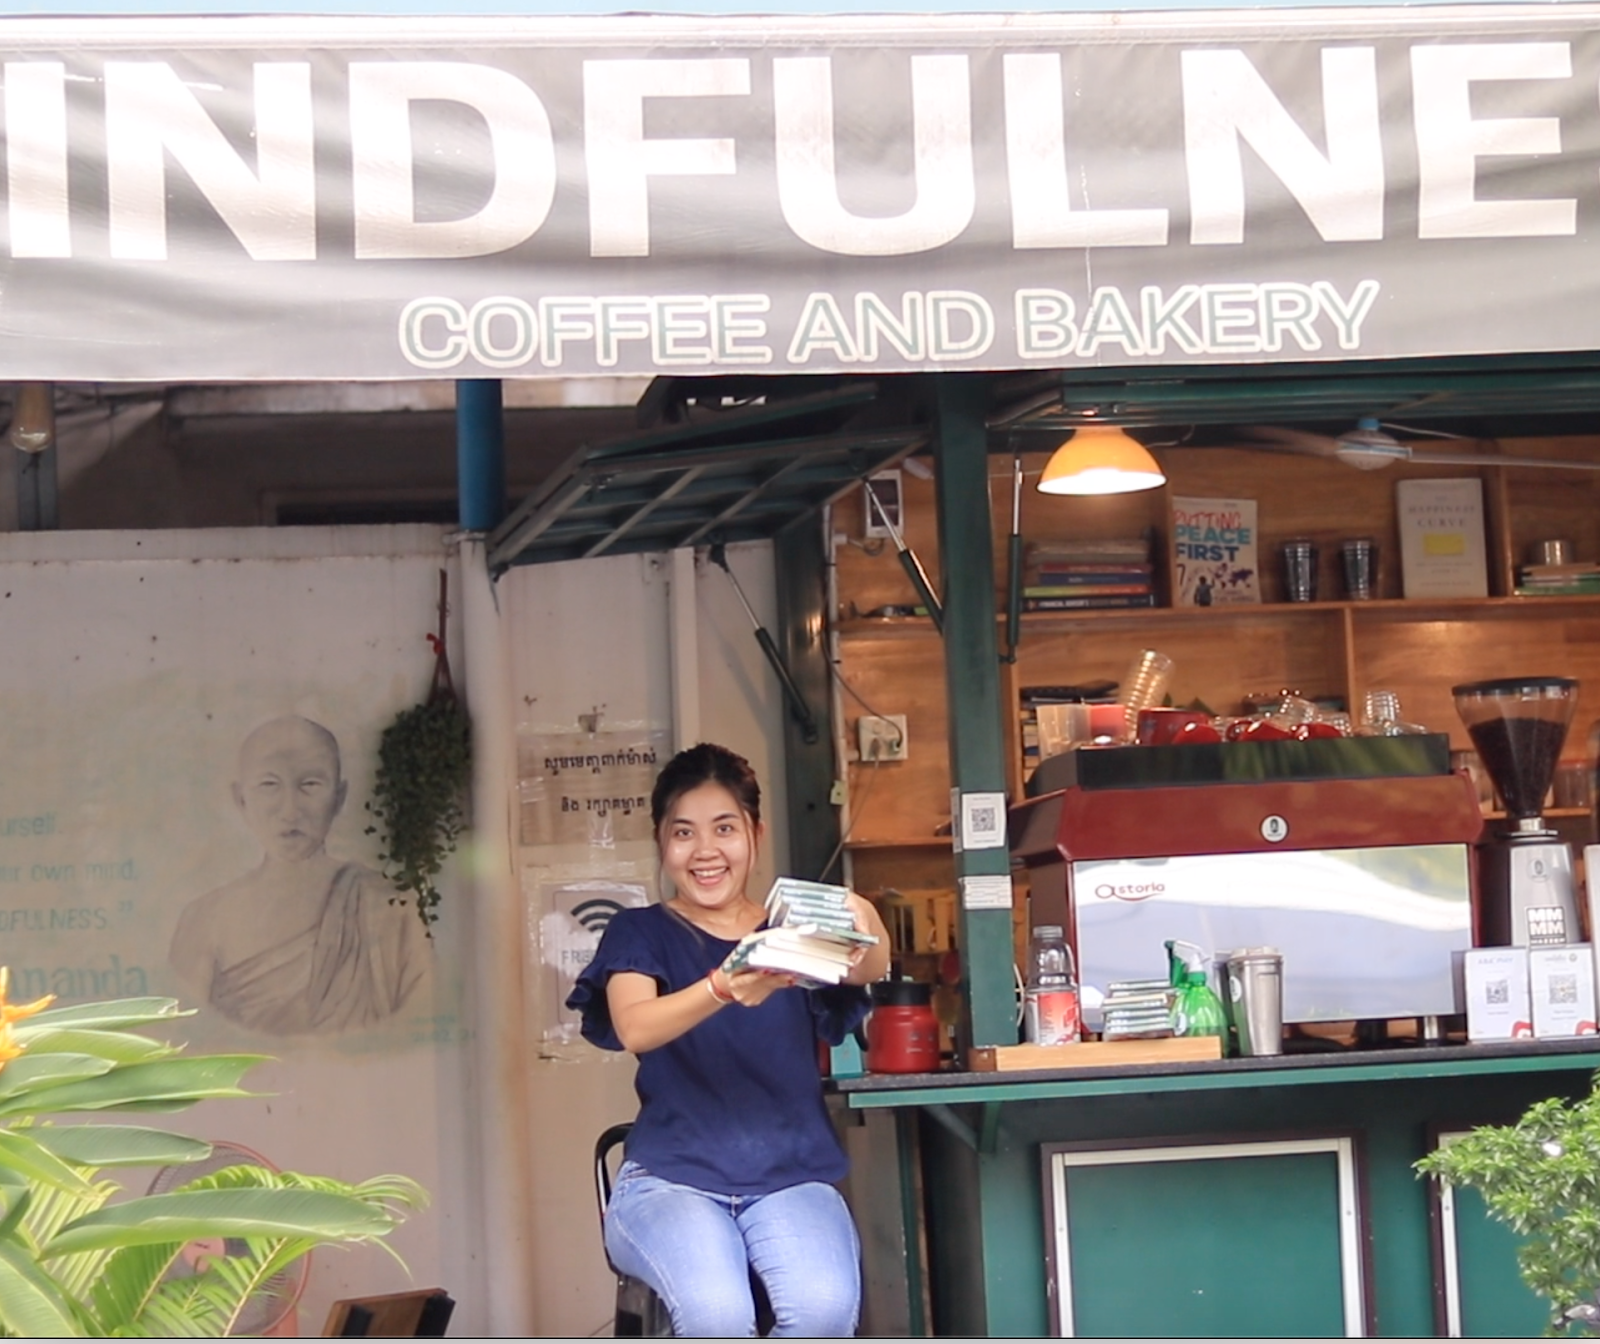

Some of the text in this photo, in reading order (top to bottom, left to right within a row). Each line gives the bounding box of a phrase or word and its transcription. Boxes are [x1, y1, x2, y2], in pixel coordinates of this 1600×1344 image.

[399, 280, 1380, 369] COFFEE AND BAKERY
[1175, 510, 1241, 530] PUTTING
[1175, 526, 1251, 545] PEACE
[1176, 542, 1239, 562] FIRST
[30, 862, 75, 883] own
[561, 949, 597, 965] FRE
